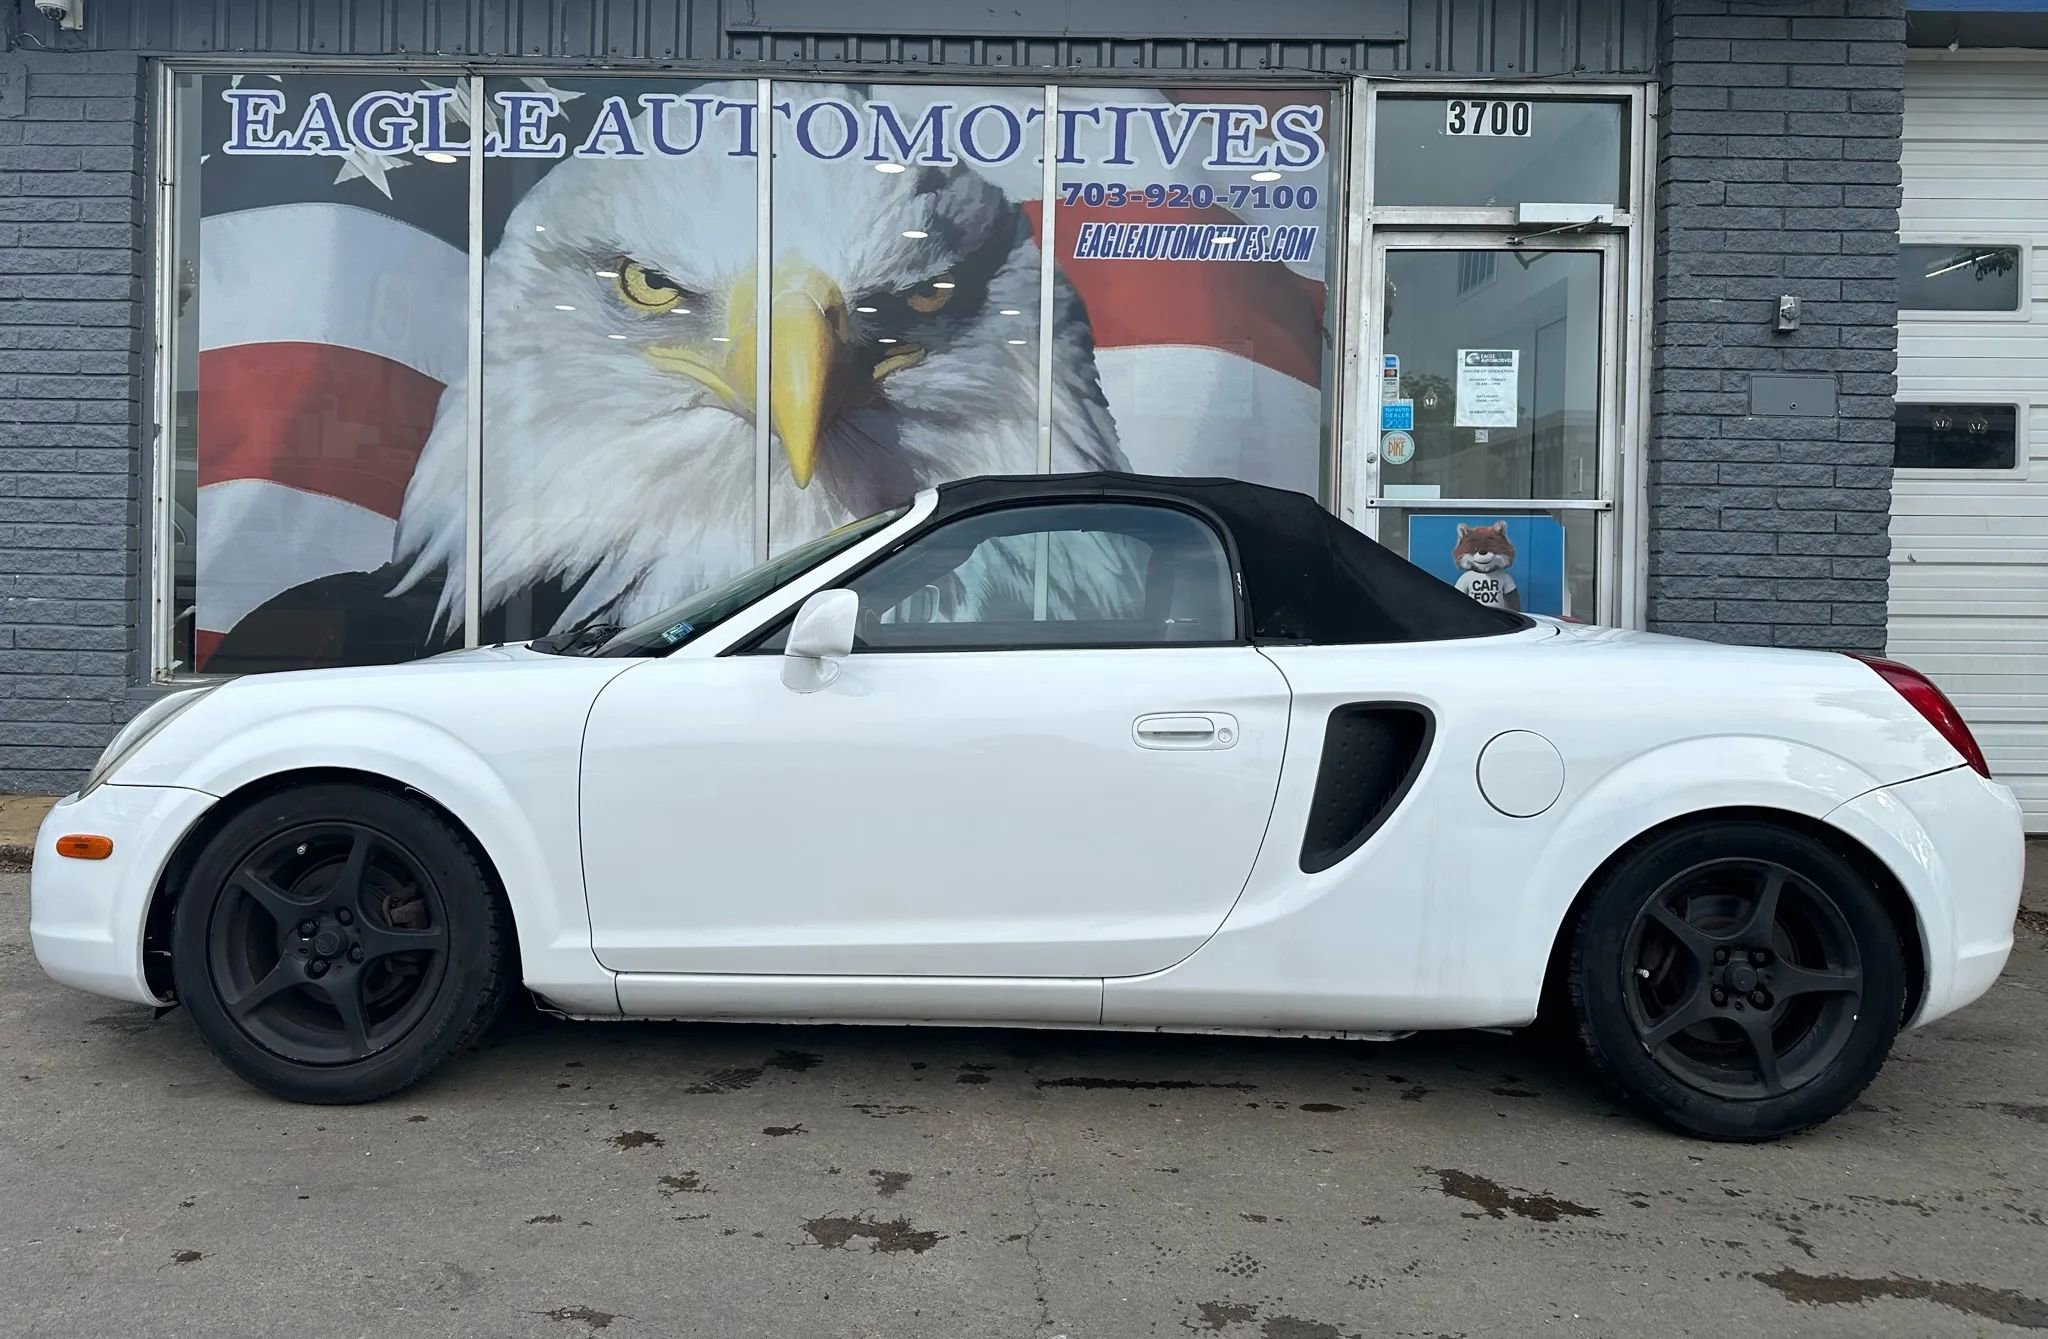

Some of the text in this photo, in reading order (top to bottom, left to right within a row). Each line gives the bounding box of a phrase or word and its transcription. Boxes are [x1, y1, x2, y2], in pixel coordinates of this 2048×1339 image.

[222, 89, 1326, 171] EAGLE AUTOMOTIVES
[1448, 100, 1530, 136] 3700
[1061, 182, 1319, 210] 703-920-7100
[1073, 222, 1321, 262] EAGLEAUTOMOTIVES.COM
[1385, 418, 1409, 428] 2021
[1387, 440, 1406, 457] PIKE
[1472, 579, 1499, 592] CAR
